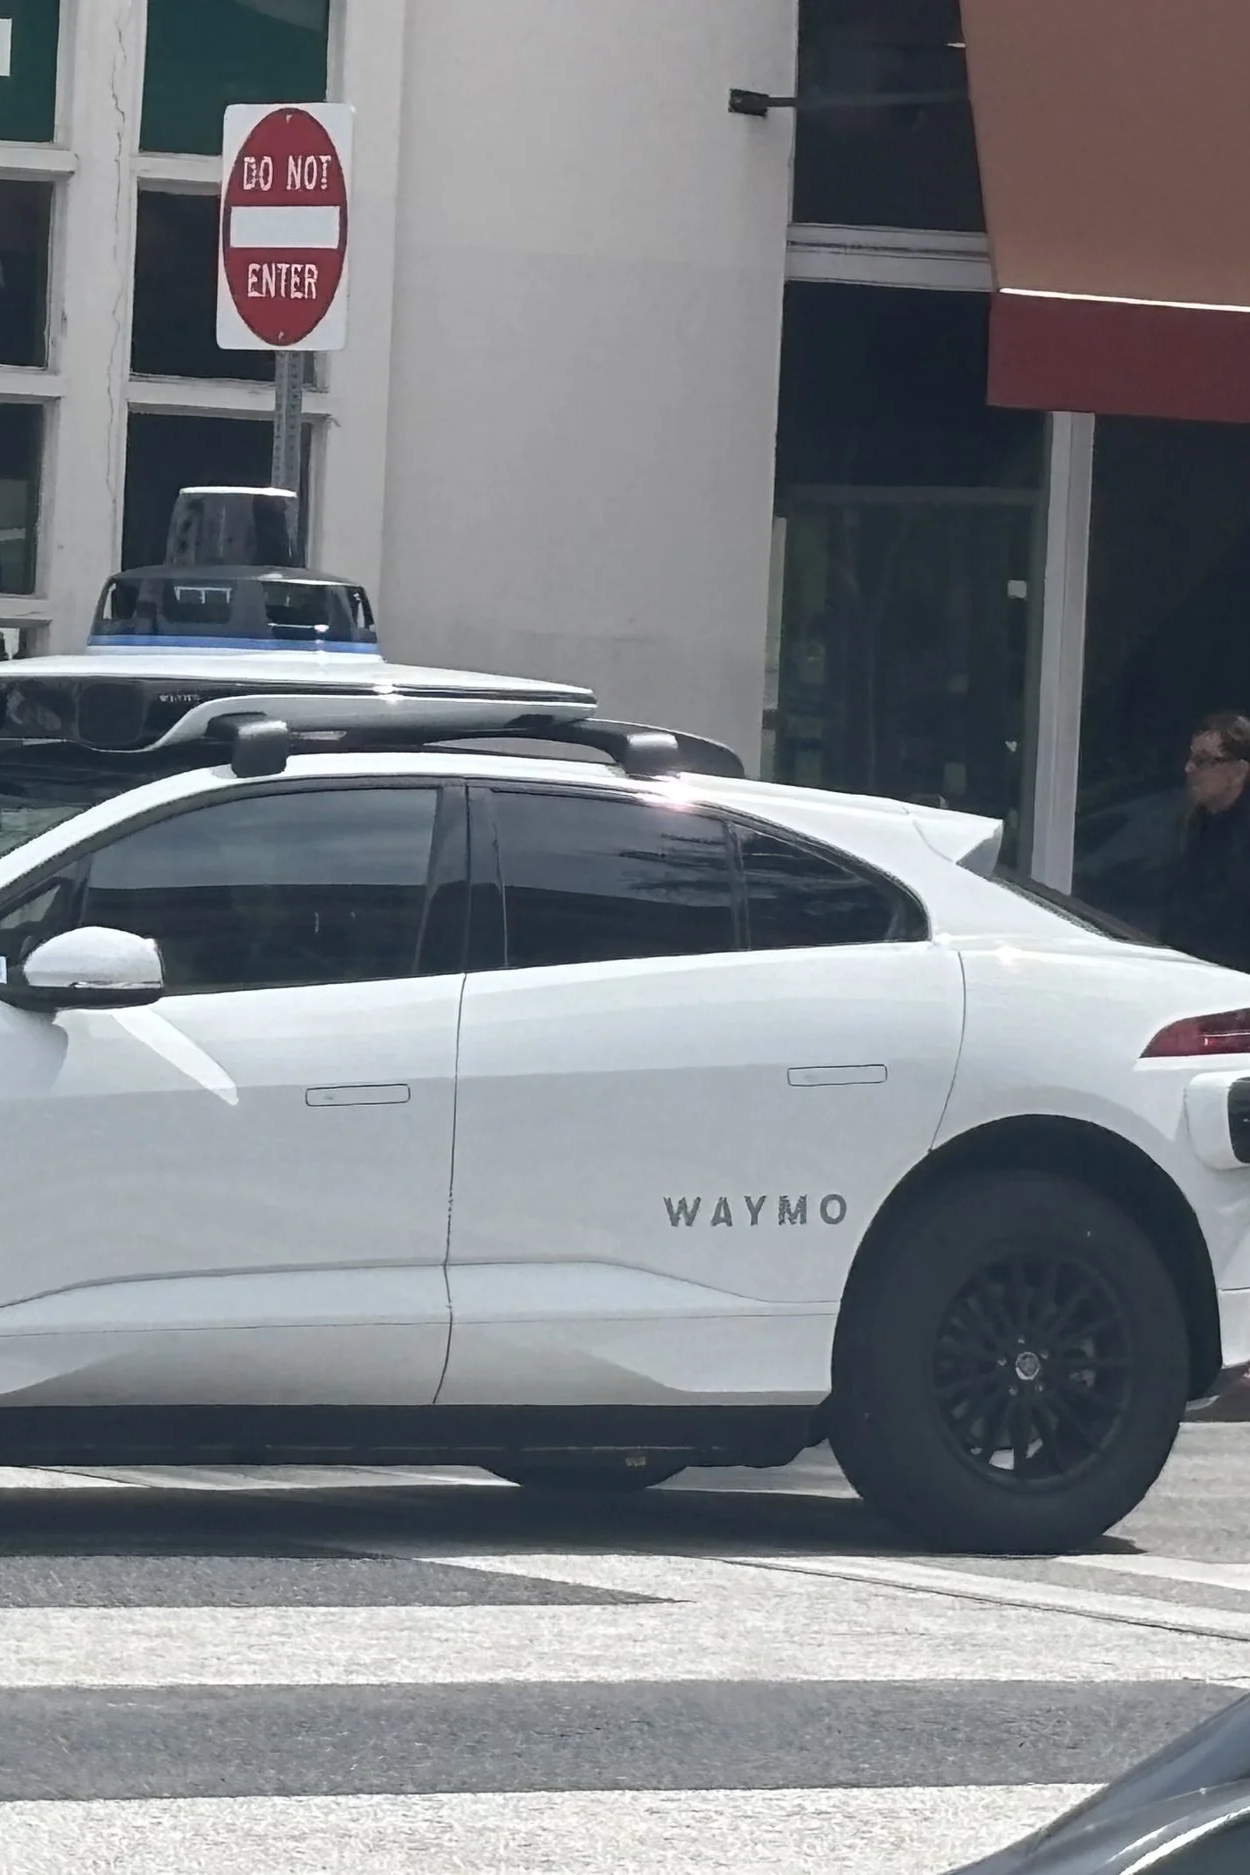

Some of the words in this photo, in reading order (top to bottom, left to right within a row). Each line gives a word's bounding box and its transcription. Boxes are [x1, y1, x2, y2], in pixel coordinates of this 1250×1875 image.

[243, 156, 273, 191] DO
[286, 155, 332, 191] NOT
[248, 263, 318, 299] ENTER
[663, 1193, 847, 1228] WAYMO
